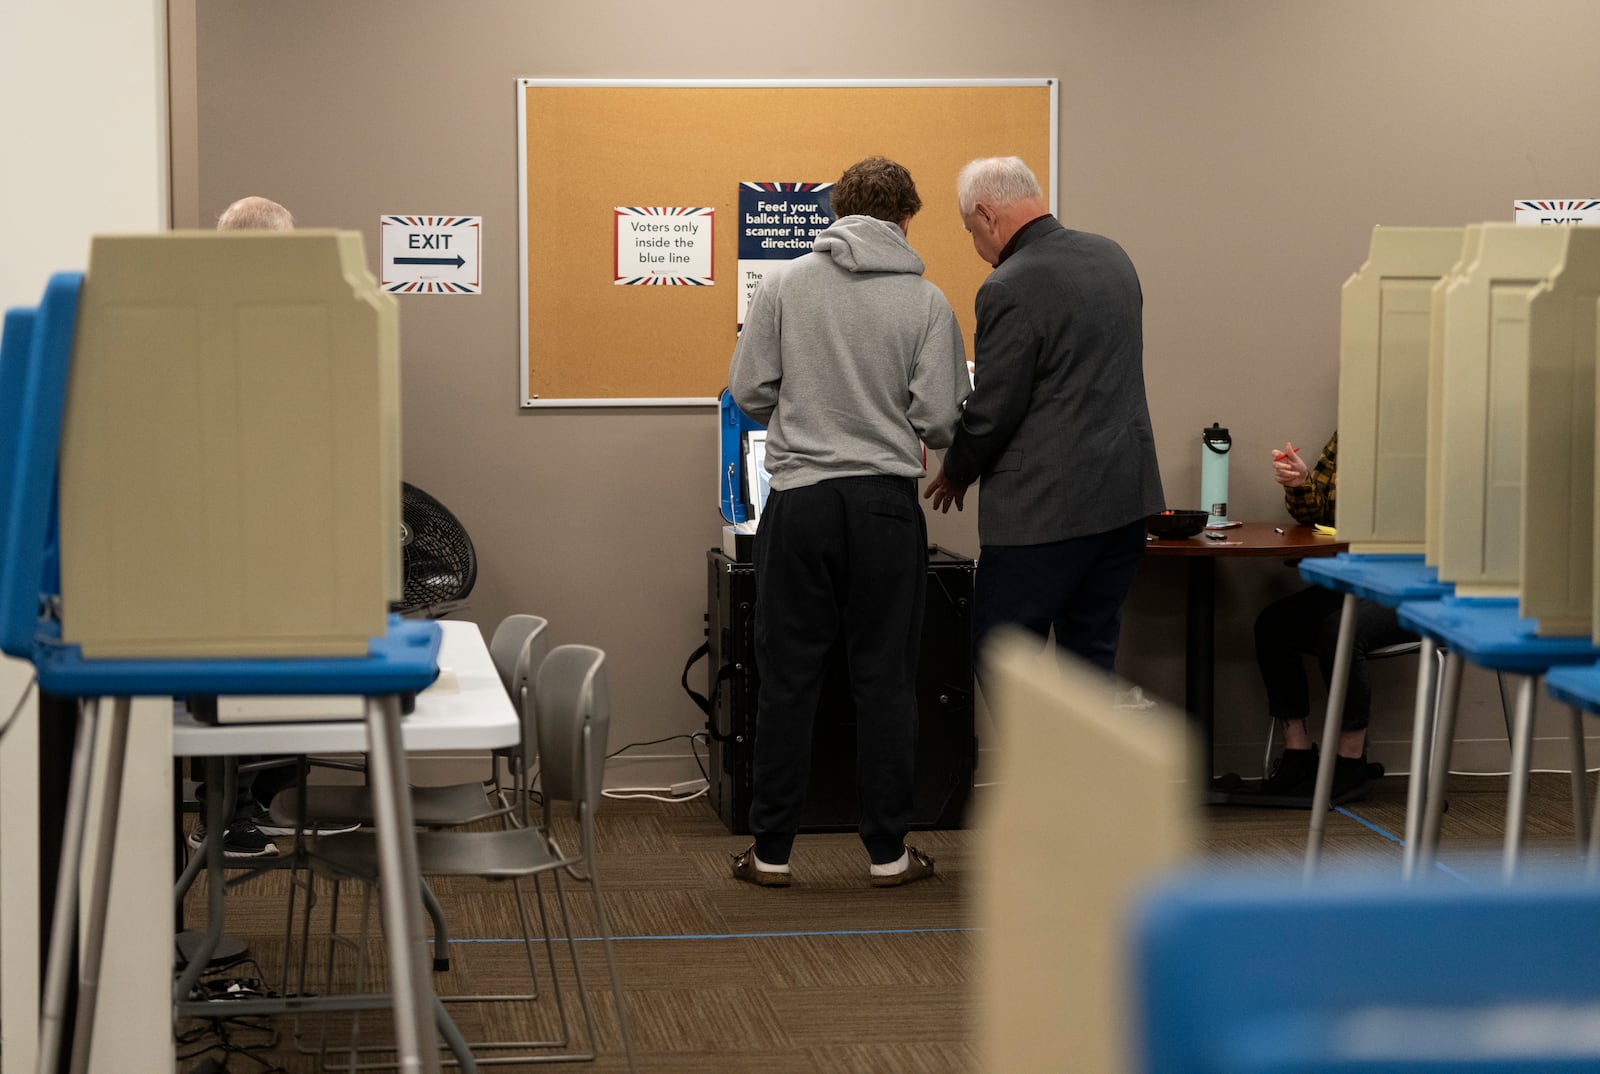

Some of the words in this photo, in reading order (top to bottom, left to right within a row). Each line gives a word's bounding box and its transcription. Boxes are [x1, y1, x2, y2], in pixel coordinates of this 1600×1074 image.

[757, 201, 787, 212] Feed
[790, 204, 818, 215] your
[745, 213, 780, 224] ballot
[783, 213, 806, 224] into
[809, 213, 830, 224] the
[631, 221, 670, 232] Voters
[673, 221, 699, 235] only
[745, 228, 791, 236] scanner
[794, 226, 805, 236] in
[408, 234, 453, 249] EXIT
[635, 237, 670, 247] inside
[675, 237, 694, 247] the
[639, 252, 665, 263] blue
[669, 252, 690, 263] line
